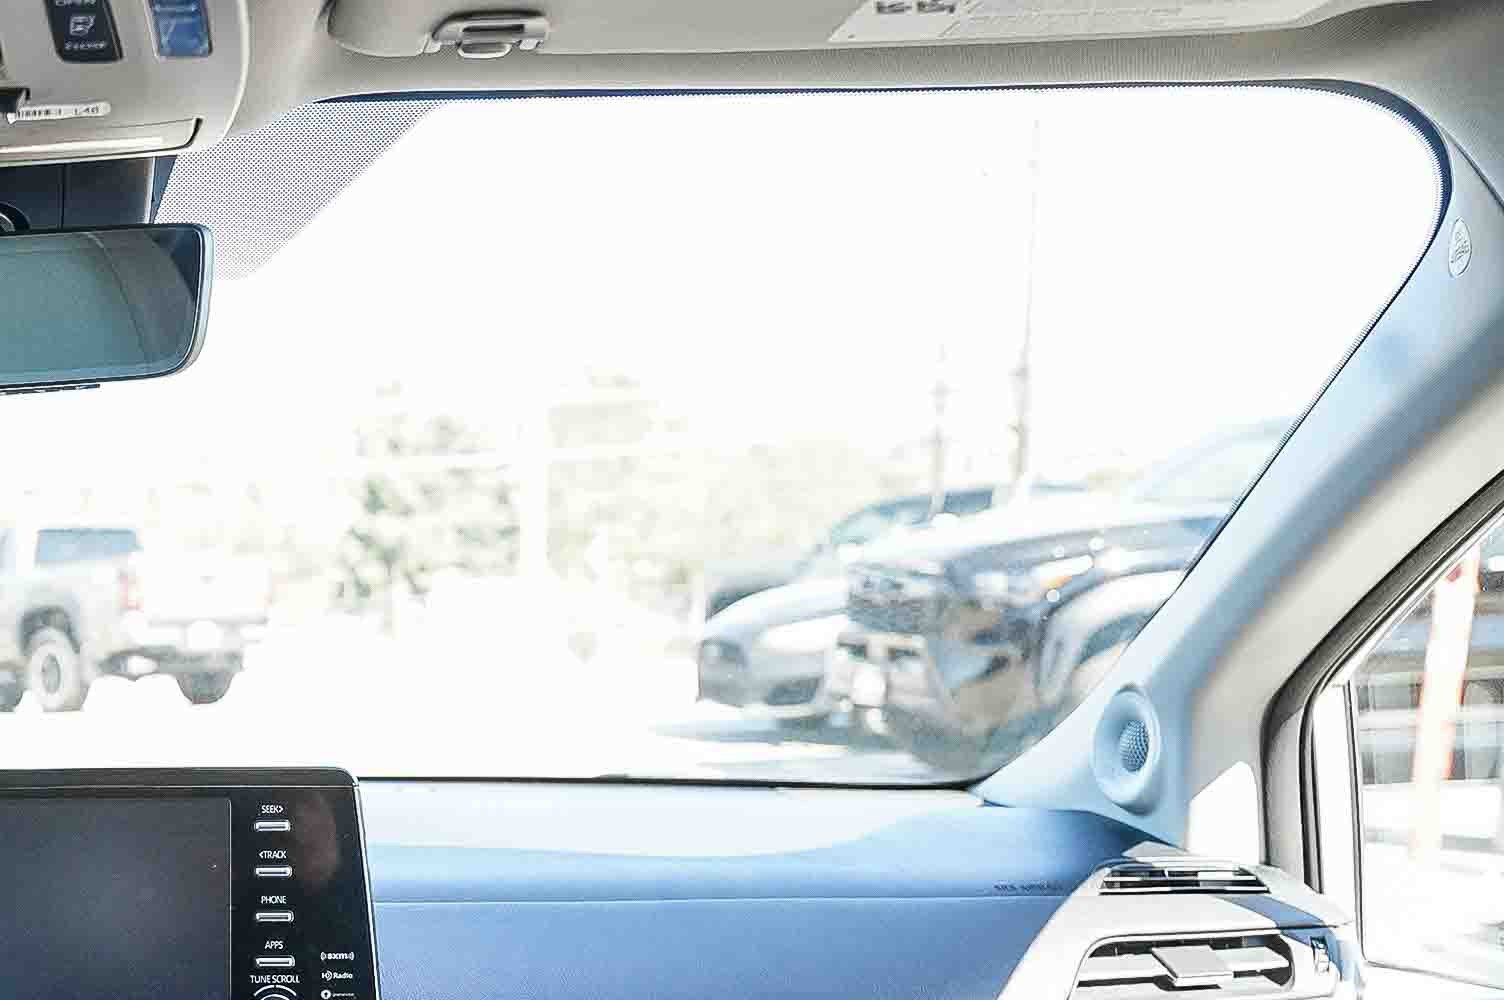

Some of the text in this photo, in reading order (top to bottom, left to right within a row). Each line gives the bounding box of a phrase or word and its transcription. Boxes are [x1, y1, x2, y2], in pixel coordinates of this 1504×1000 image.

[260, 895, 287, 904] PHONE
[264, 940, 284, 950] APPS
[249, 974, 301, 984] TUNE SCROLL
